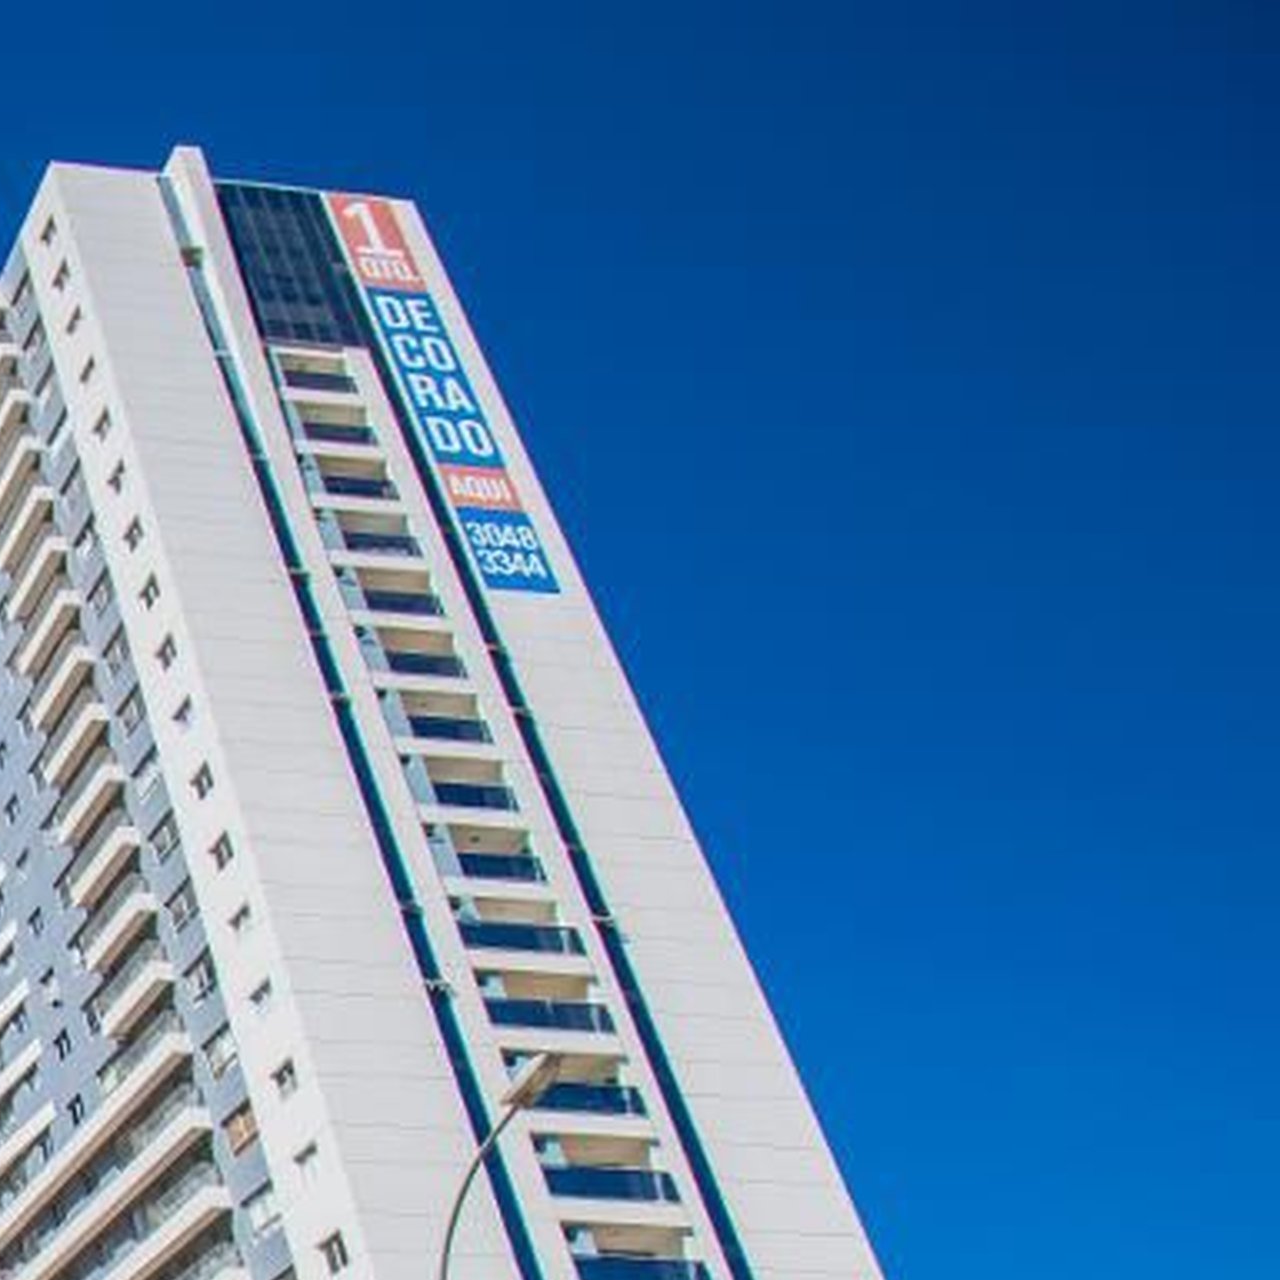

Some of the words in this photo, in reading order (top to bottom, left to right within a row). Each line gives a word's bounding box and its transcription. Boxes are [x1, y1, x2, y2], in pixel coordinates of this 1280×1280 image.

[342, 200, 404, 259] 1
[448, 474, 513, 502] AQUI
[466, 521, 538, 551] 3048
[476, 549, 548, 579] 3344
